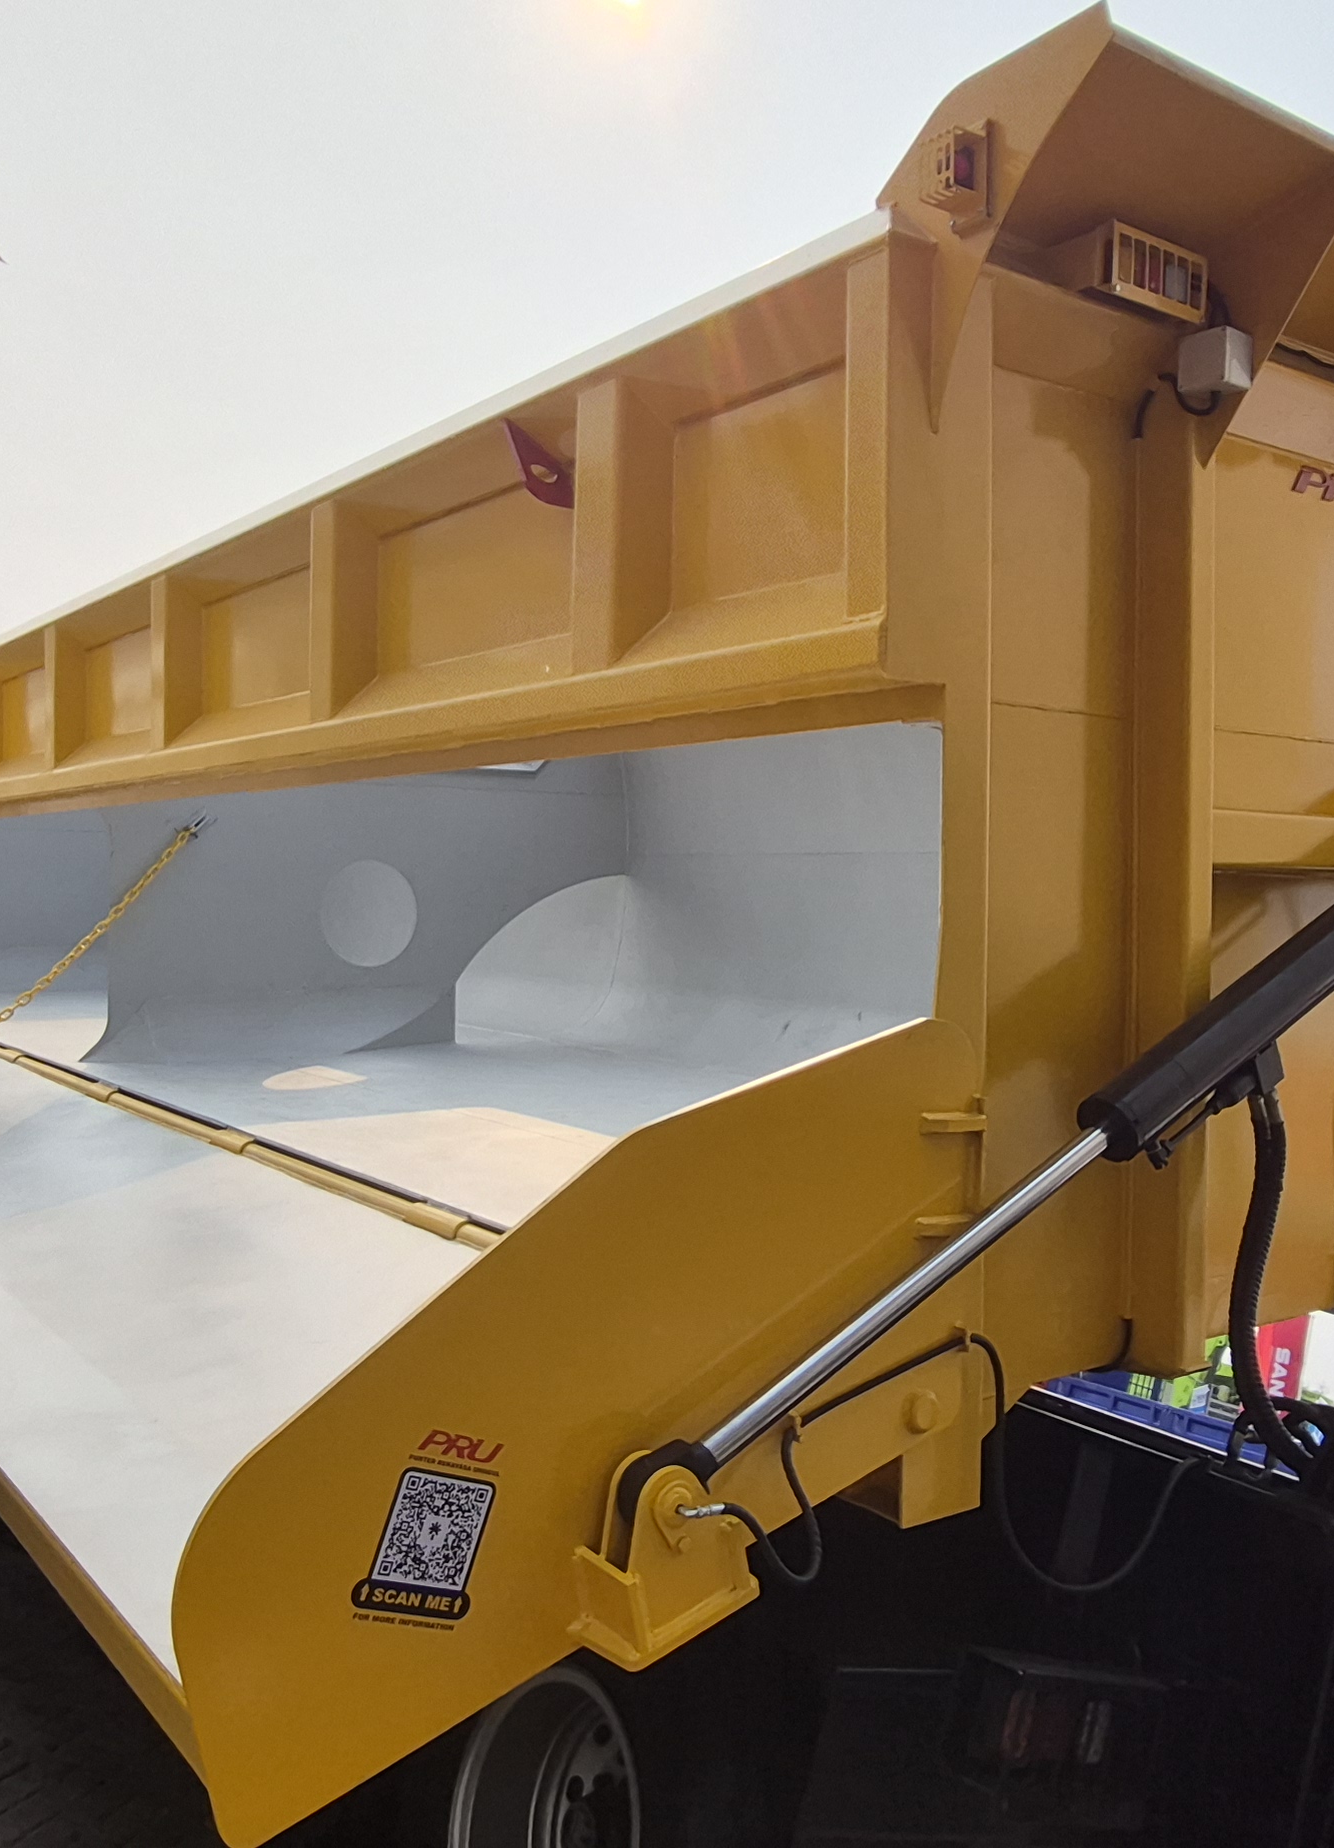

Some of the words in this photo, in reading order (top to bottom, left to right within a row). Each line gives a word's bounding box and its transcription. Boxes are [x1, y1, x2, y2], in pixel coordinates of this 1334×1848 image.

[1269, 1346, 1291, 1398] SAN
[417, 1429, 504, 1463] PRU
[372, 1588, 422, 1607] SCAN
[425, 1594, 452, 1611] ME
